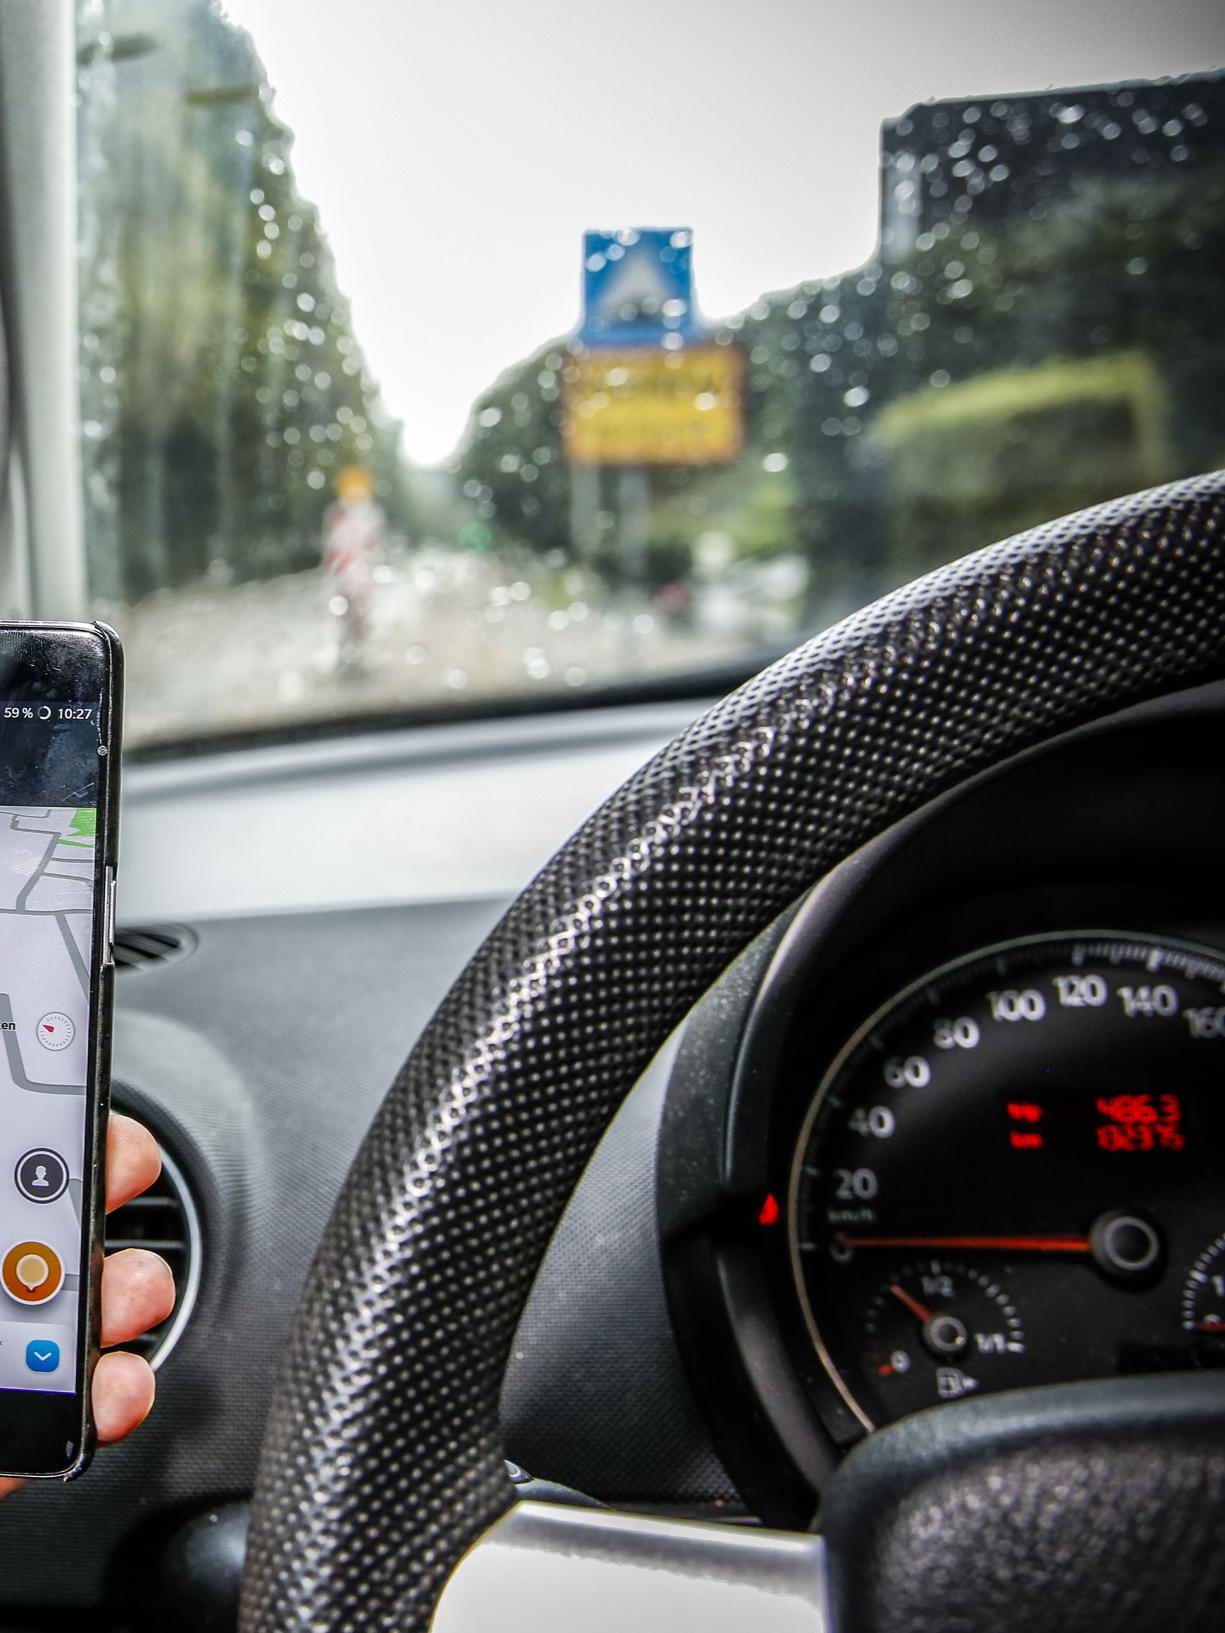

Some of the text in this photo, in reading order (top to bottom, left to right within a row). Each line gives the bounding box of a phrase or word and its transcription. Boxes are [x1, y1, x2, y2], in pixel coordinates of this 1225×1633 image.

[3, 707, 20, 718] 59
[22, 707, 34, 719] %
[57, 708, 93, 720] 10:27
[986, 988, 1047, 1022] 100
[1052, 974, 1107, 1007] 120
[1116, 984, 1179, 1018] 140
[933, 1016, 980, 1049] 80
[883, 1055, 931, 1088] 60
[848, 1105, 895, 1139] 40
[834, 1167, 877, 1199] 20
